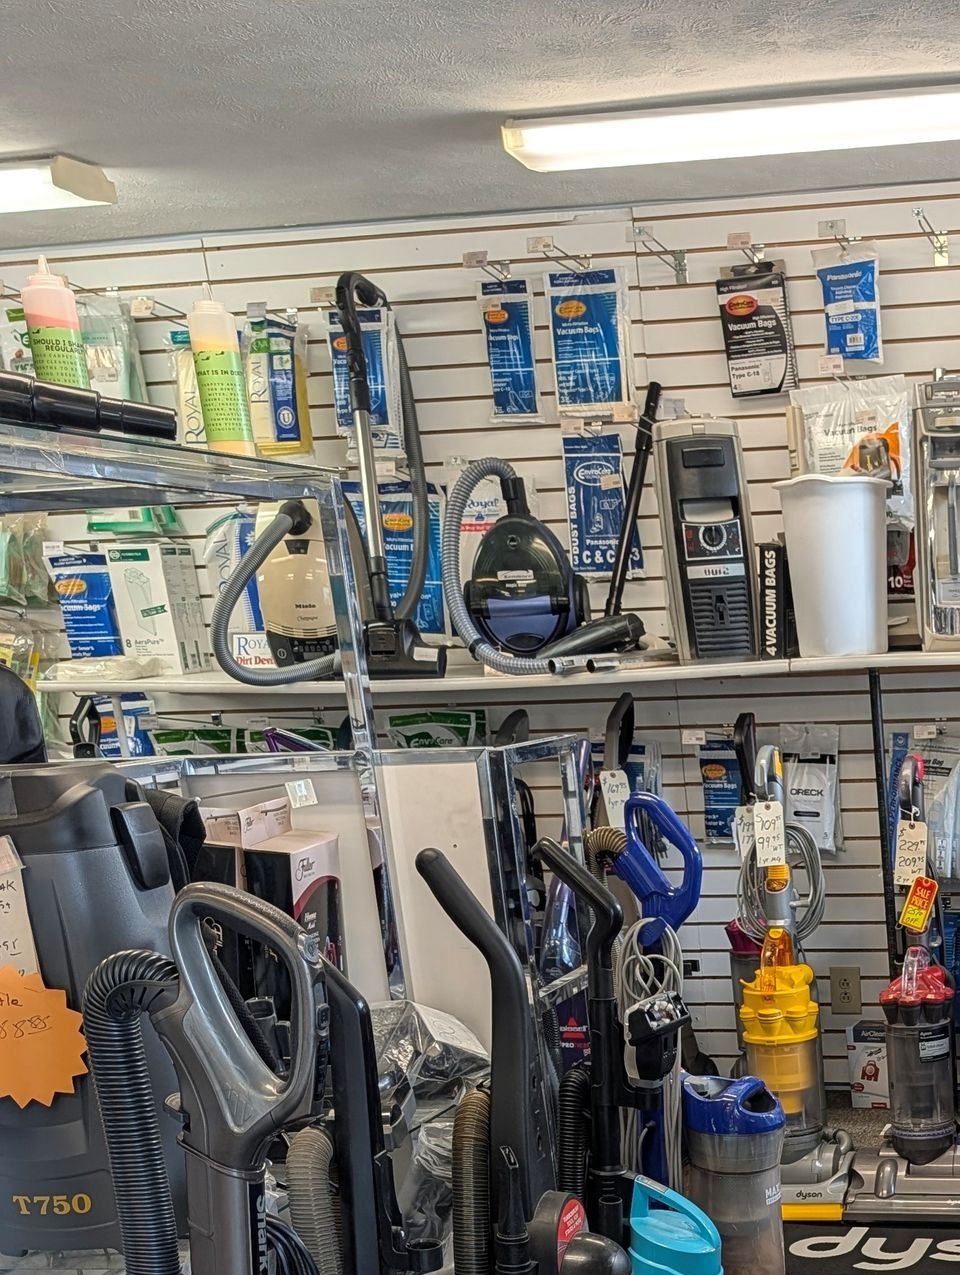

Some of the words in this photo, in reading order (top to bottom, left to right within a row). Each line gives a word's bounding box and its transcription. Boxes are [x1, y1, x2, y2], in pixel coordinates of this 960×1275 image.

[827, 270, 863, 282] Panasonic
[556, 326, 581, 336] Vacuum
[582, 326, 599, 337] Bags
[728, 322, 756, 331] Vacuum
[758, 320, 777, 330] Bags
[33, 337, 59, 346] SHOULD
[731, 363, 761, 373] Panasonic
[252, 360, 268, 401] ROYAL
[732, 372, 747, 380] Type
[566, 486, 575, 519] BAGS
[570, 518, 578, 556] DUST
[586, 537, 619, 547] Panasonic
[582, 550, 592, 563] C
[766, 549, 777, 586] BAGS
[888, 576, 902, 589] 10
[765, 587, 777, 647] VACUUM
[253, 655, 276, 667] Devi
[411, 736, 454, 747] EnviroCare
[789, 788, 824, 798] ORECK
[915, 886, 931, 901] SALE
[911, 894, 930, 910] PRICE
[796, 1190, 823, 1200] dyson
[12, 1192, 93, 1215] T750
